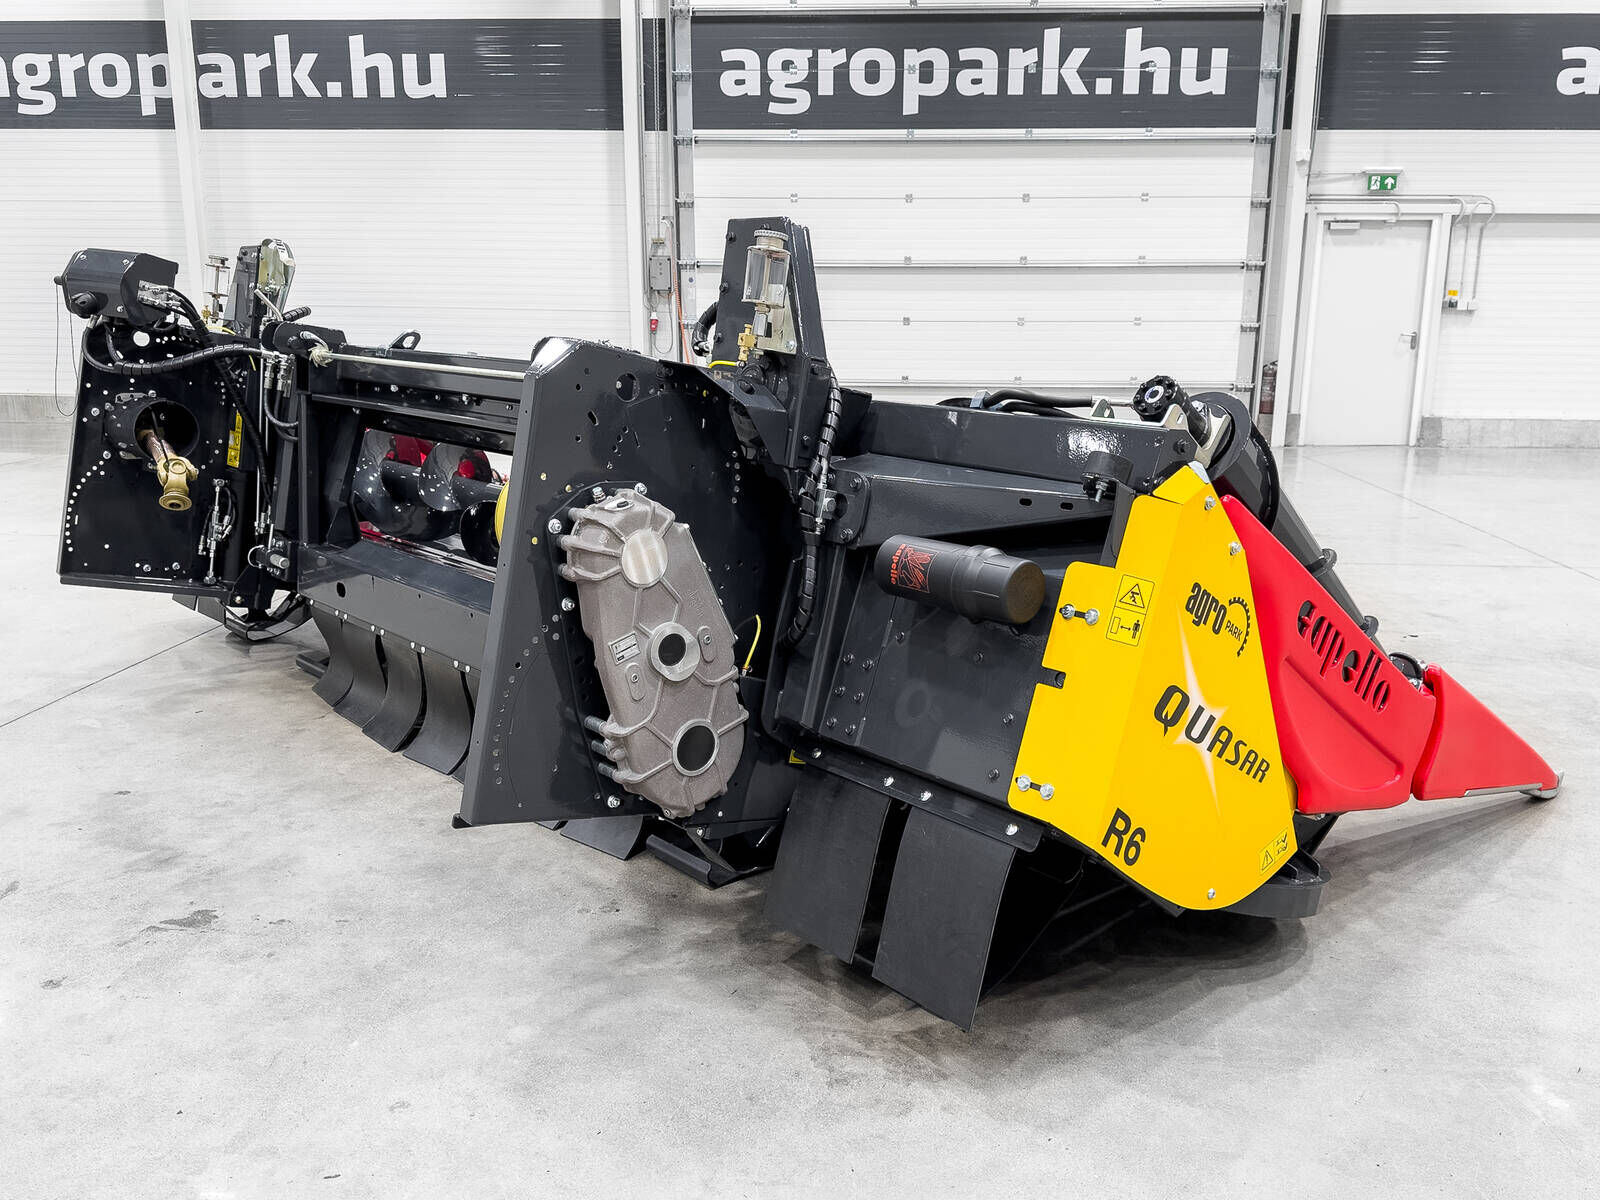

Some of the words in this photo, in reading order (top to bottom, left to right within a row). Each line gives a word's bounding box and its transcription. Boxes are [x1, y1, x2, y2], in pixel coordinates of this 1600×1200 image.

[0, 34, 447, 116] gropark.hu
[719, 27, 1228, 116] agropark.hu
[1185, 582, 1227, 635] agro
[1225, 620, 1243, 641] PARK
[1297, 600, 1391, 713] capello
[1154, 684, 1270, 783] QUASAR
[1102, 808, 1146, 866] R6
